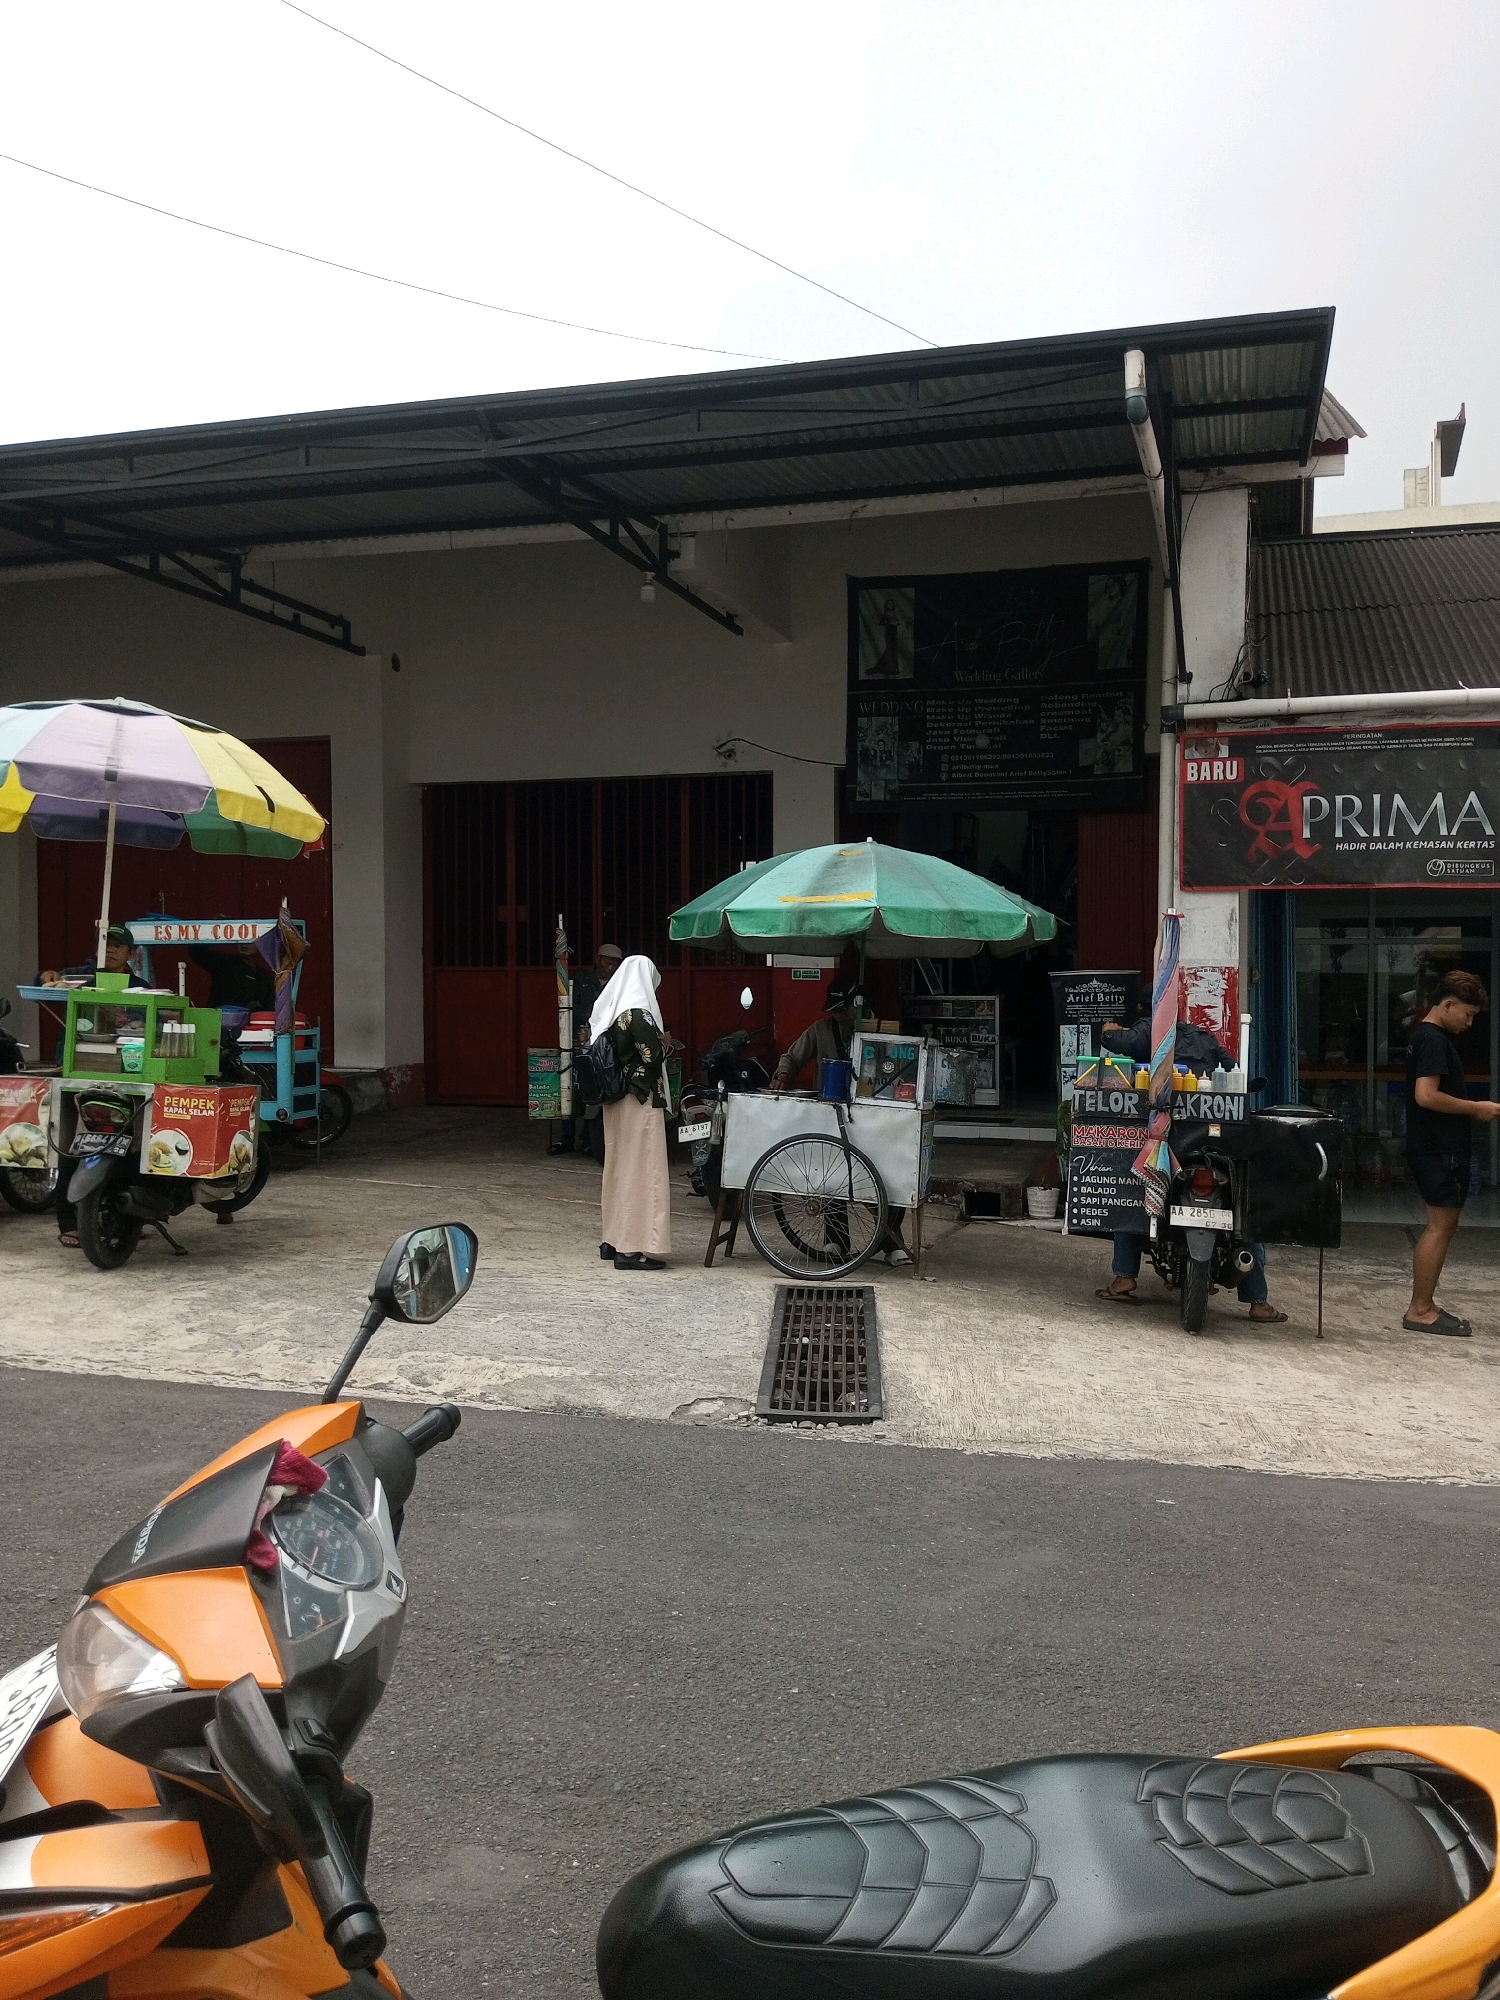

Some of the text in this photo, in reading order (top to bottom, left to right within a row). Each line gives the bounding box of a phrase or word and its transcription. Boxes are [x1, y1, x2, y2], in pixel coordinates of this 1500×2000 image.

[954, 667, 1044, 684] Wedding Gallery
[859, 700, 924, 715] WEDDING
[1186, 760, 1238, 781] BARU
[1302, 791, 1496, 838] PRIMA
[1335, 840, 1495, 850] HADIR DALAM KEMASAN KERTAS
[154, 923, 259, 941] ES MY COOL
[944, 1034, 997, 1044] BUKA BUKA
[164, 1096, 215, 1110] PEMPEK
[1072, 1089, 1244, 1120] TELOR AKRONI
[163, 1106, 187, 1115] KAPAL
[189, 1108, 215, 1117] SELAM
[680, 1123, 708, 1135] AA 6197
[1072, 1125, 1150, 1140] MAKARON
[1072, 1138, 1147, 1148] BASAH & KERIN
[1080, 1175, 1143, 1186] JAGUNG MANI
[1080, 1186, 1117, 1195] BALADO
[1080, 1196, 1145, 1207] SAPI PANGGAN
[1080, 1208, 1109, 1216] PEDES
[1171, 1206, 1184, 1217] AA
[1080, 1218, 1101, 1227] ASIN
